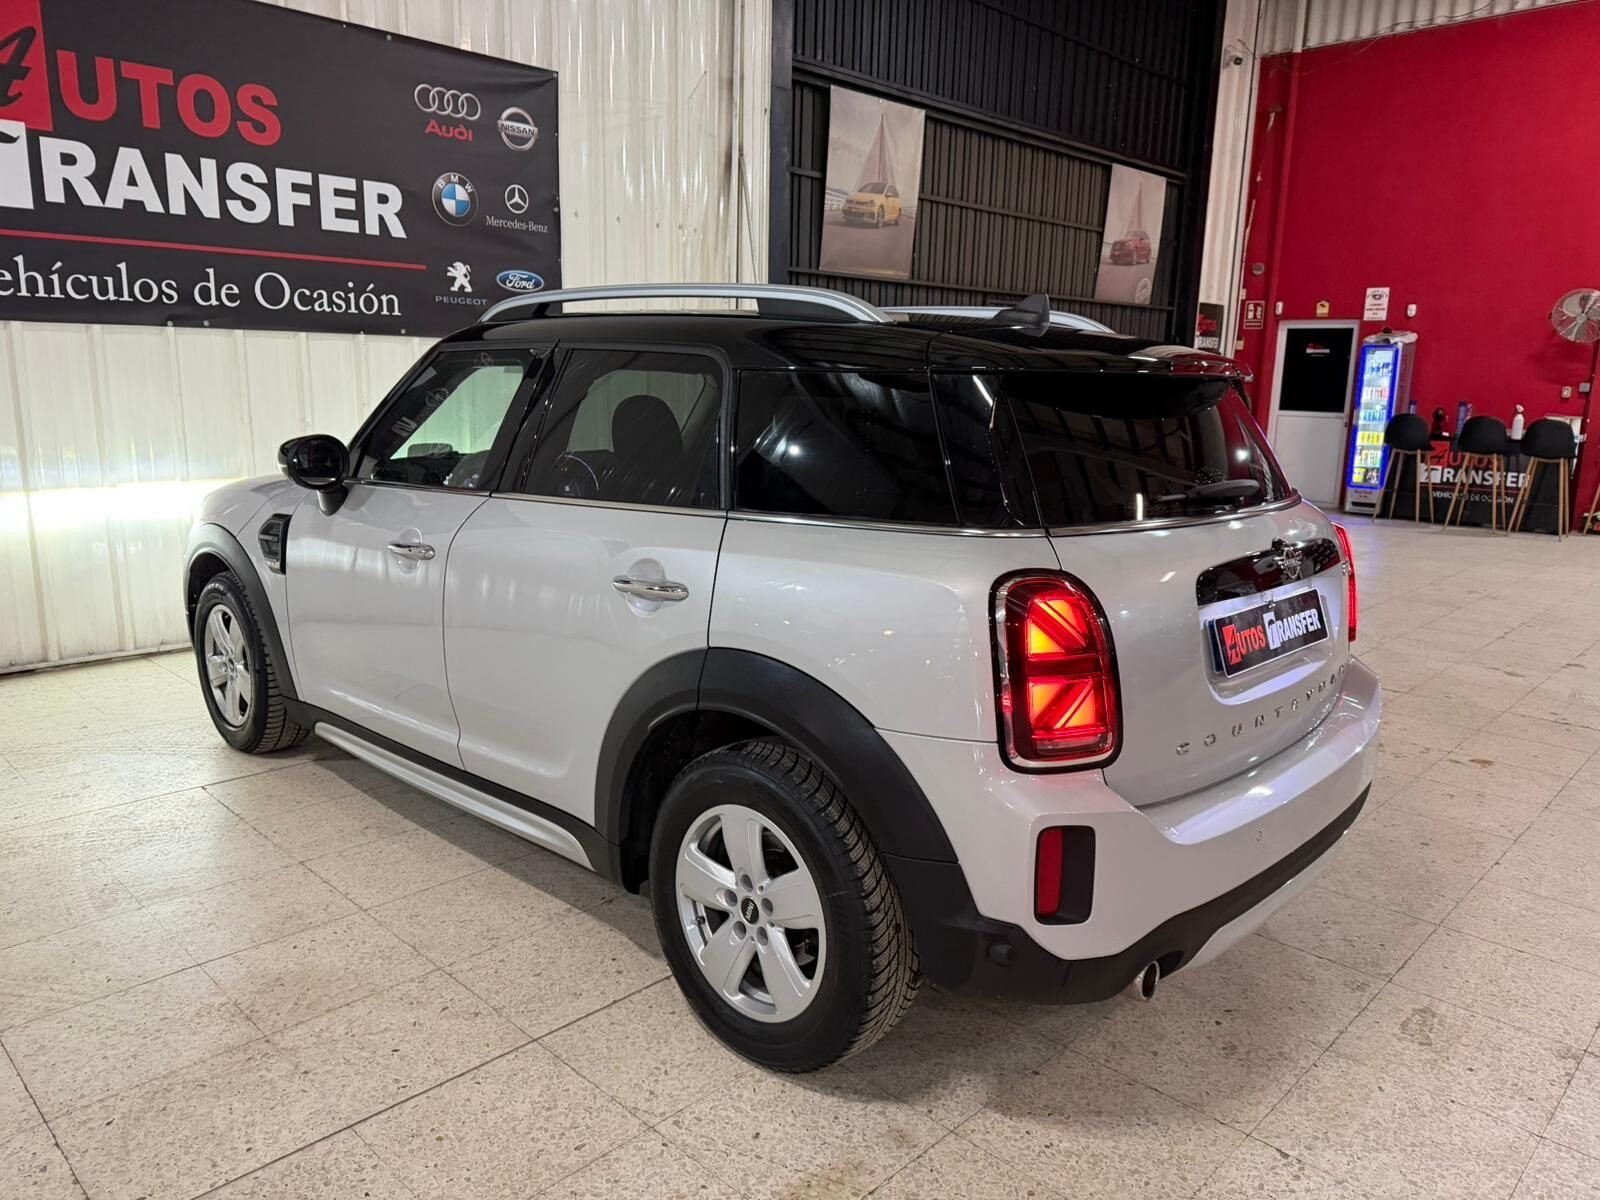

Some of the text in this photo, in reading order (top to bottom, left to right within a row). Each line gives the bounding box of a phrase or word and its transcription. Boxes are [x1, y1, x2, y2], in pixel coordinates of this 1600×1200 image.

[425, 119, 473, 141] Audi
[501, 123, 536, 136] NISSAN
[0, 122, 408, 239] RANSFER
[437, 174, 474, 193] BMW
[486, 215, 549, 233] Mercedes-Benz
[505, 274, 536, 290] Ford
[193, 268, 240, 308] de
[254, 271, 402, 316] Ocasión
[435, 296, 488, 306] PEUGEOT
[1222, 609, 1322, 665] AUTOS TRANSFER
